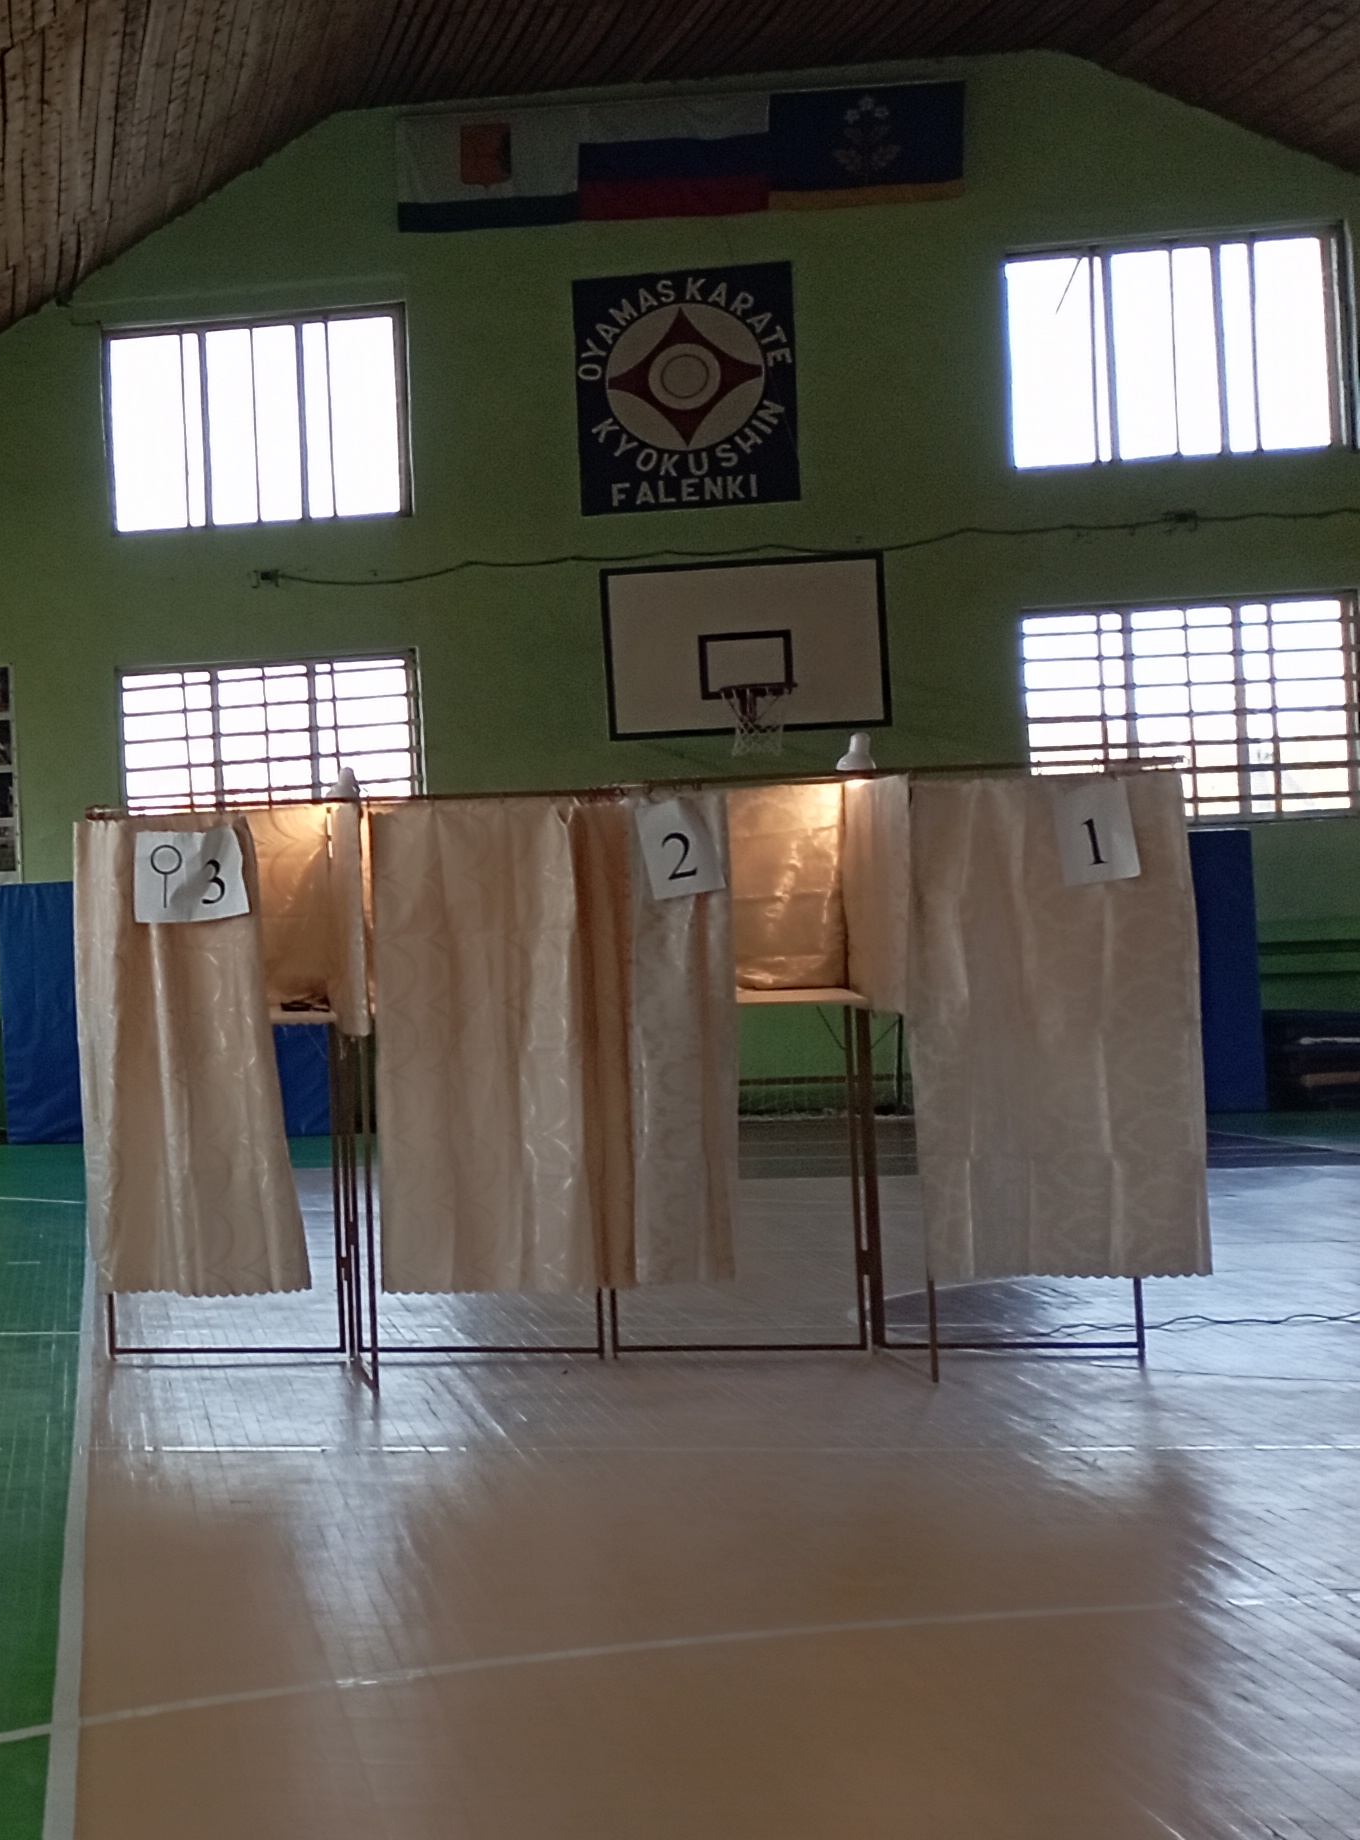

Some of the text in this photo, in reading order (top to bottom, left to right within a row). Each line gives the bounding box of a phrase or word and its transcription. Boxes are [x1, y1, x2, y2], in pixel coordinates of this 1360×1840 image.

[577, 277, 793, 381] OYAMAS KARATE
[591, 399, 785, 477] KYOKUSHIN
[611, 474, 758, 507] FALENKI
[661, 832, 698, 880] 2
[1081, 818, 1109, 866] 1
[201, 858, 225, 905] 3
